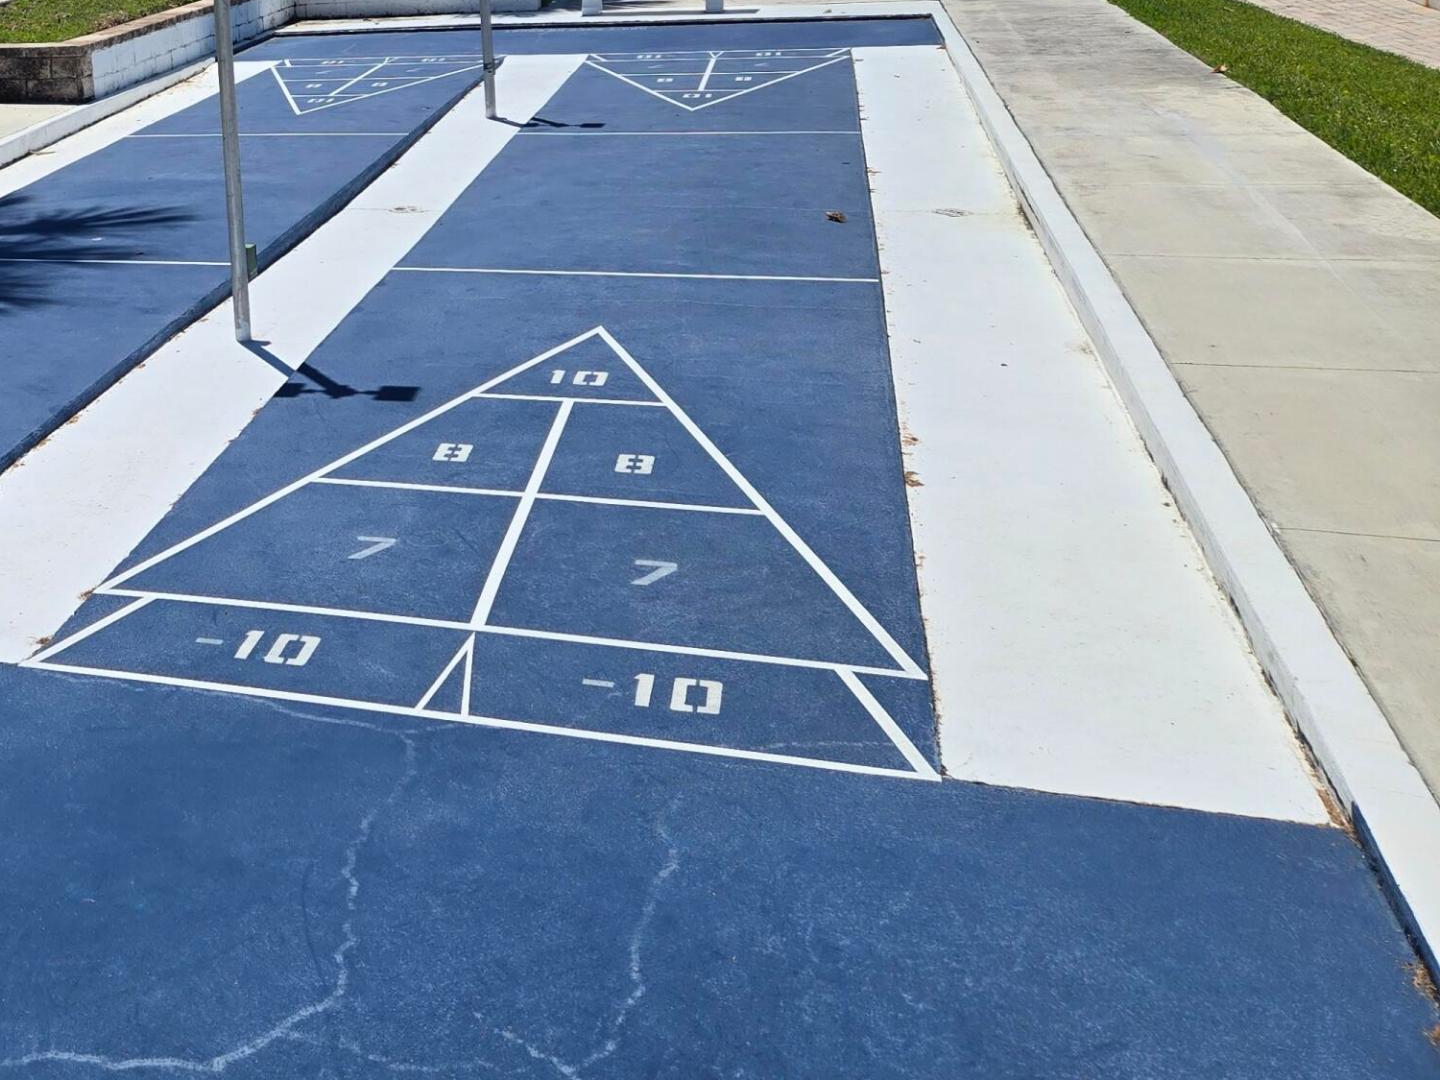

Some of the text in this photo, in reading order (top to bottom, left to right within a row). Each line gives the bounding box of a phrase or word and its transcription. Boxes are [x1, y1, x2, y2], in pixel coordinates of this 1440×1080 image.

[551, 369, 609, 387] 10
[433, 442, 474, 463] 8
[615, 453, 656, 475] 8
[348, 535, 397, 560] 7
[631, 559, 678, 586] 7
[195, 629, 322, 666] -10
[582, 673, 724, 716] -10
